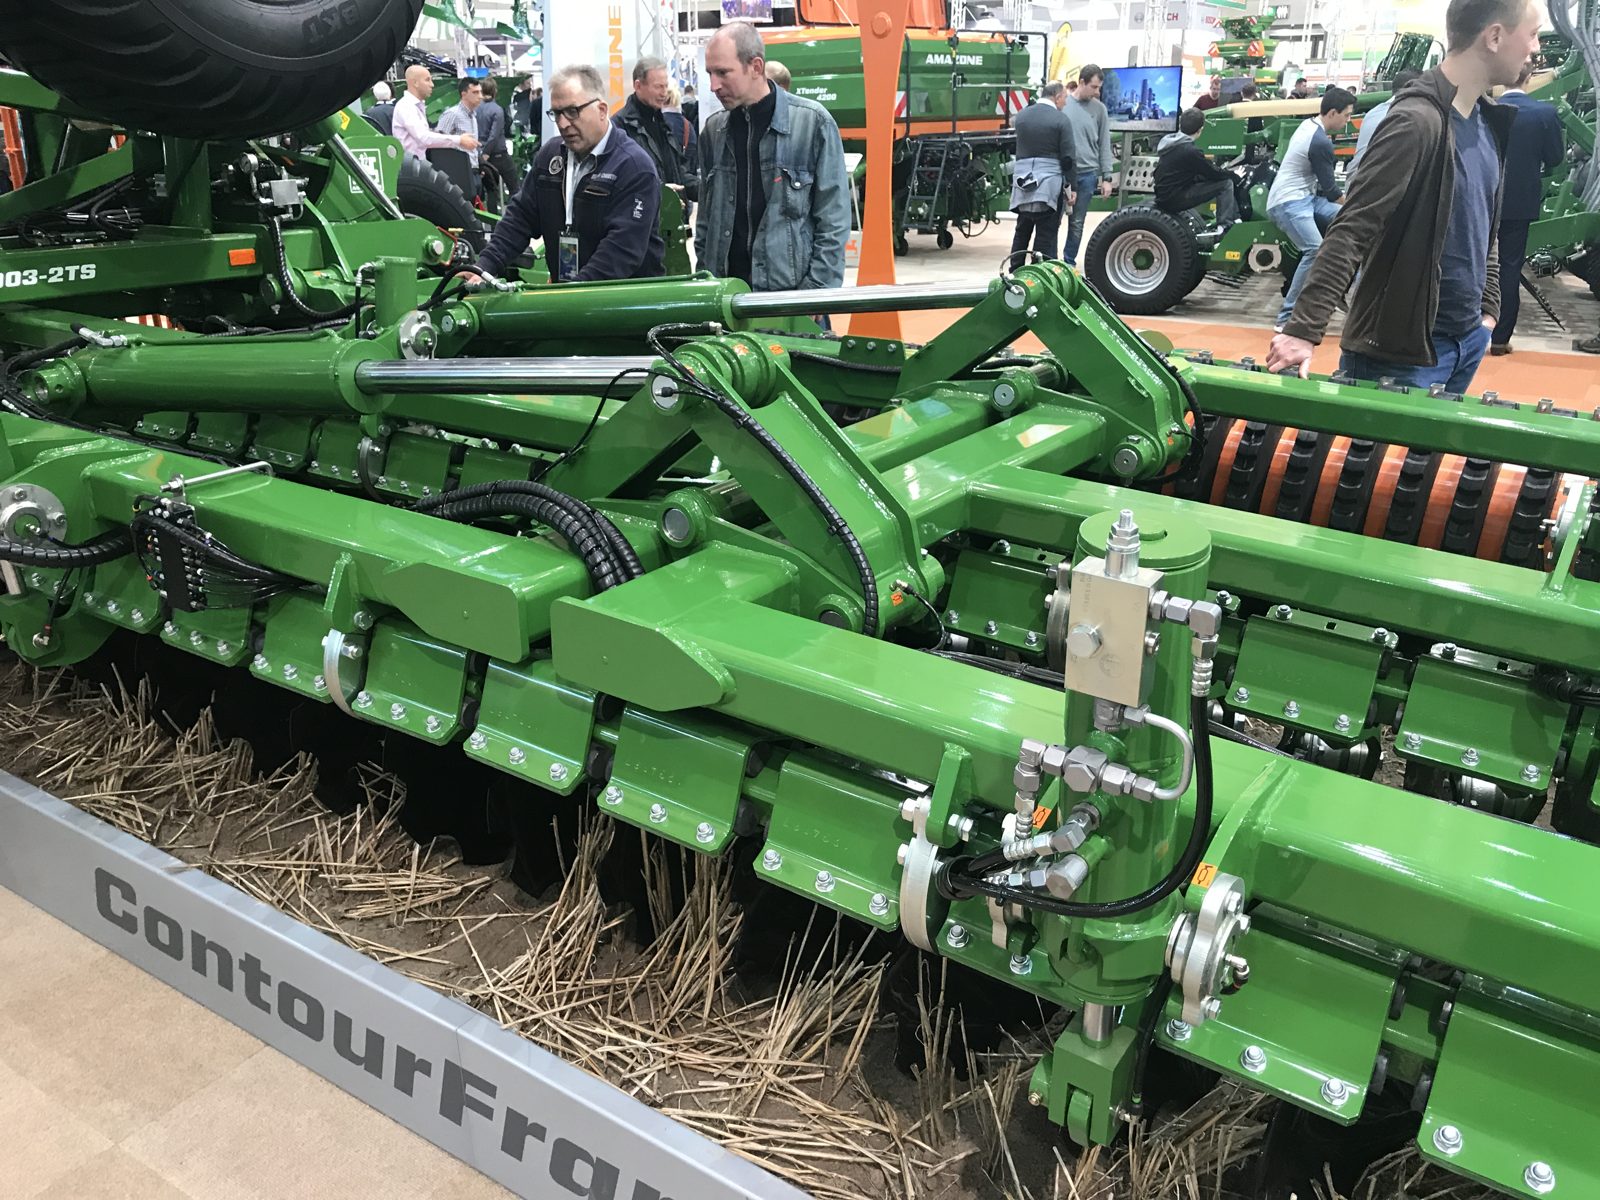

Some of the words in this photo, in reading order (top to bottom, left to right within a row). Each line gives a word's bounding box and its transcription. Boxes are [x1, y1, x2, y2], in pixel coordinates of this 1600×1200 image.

[608, 4, 624, 117] ZONE
[796, 86, 828, 95] XTender
[816, 93, 837, 101] 4200
[0, 263, 97, 288] 03-2TS
